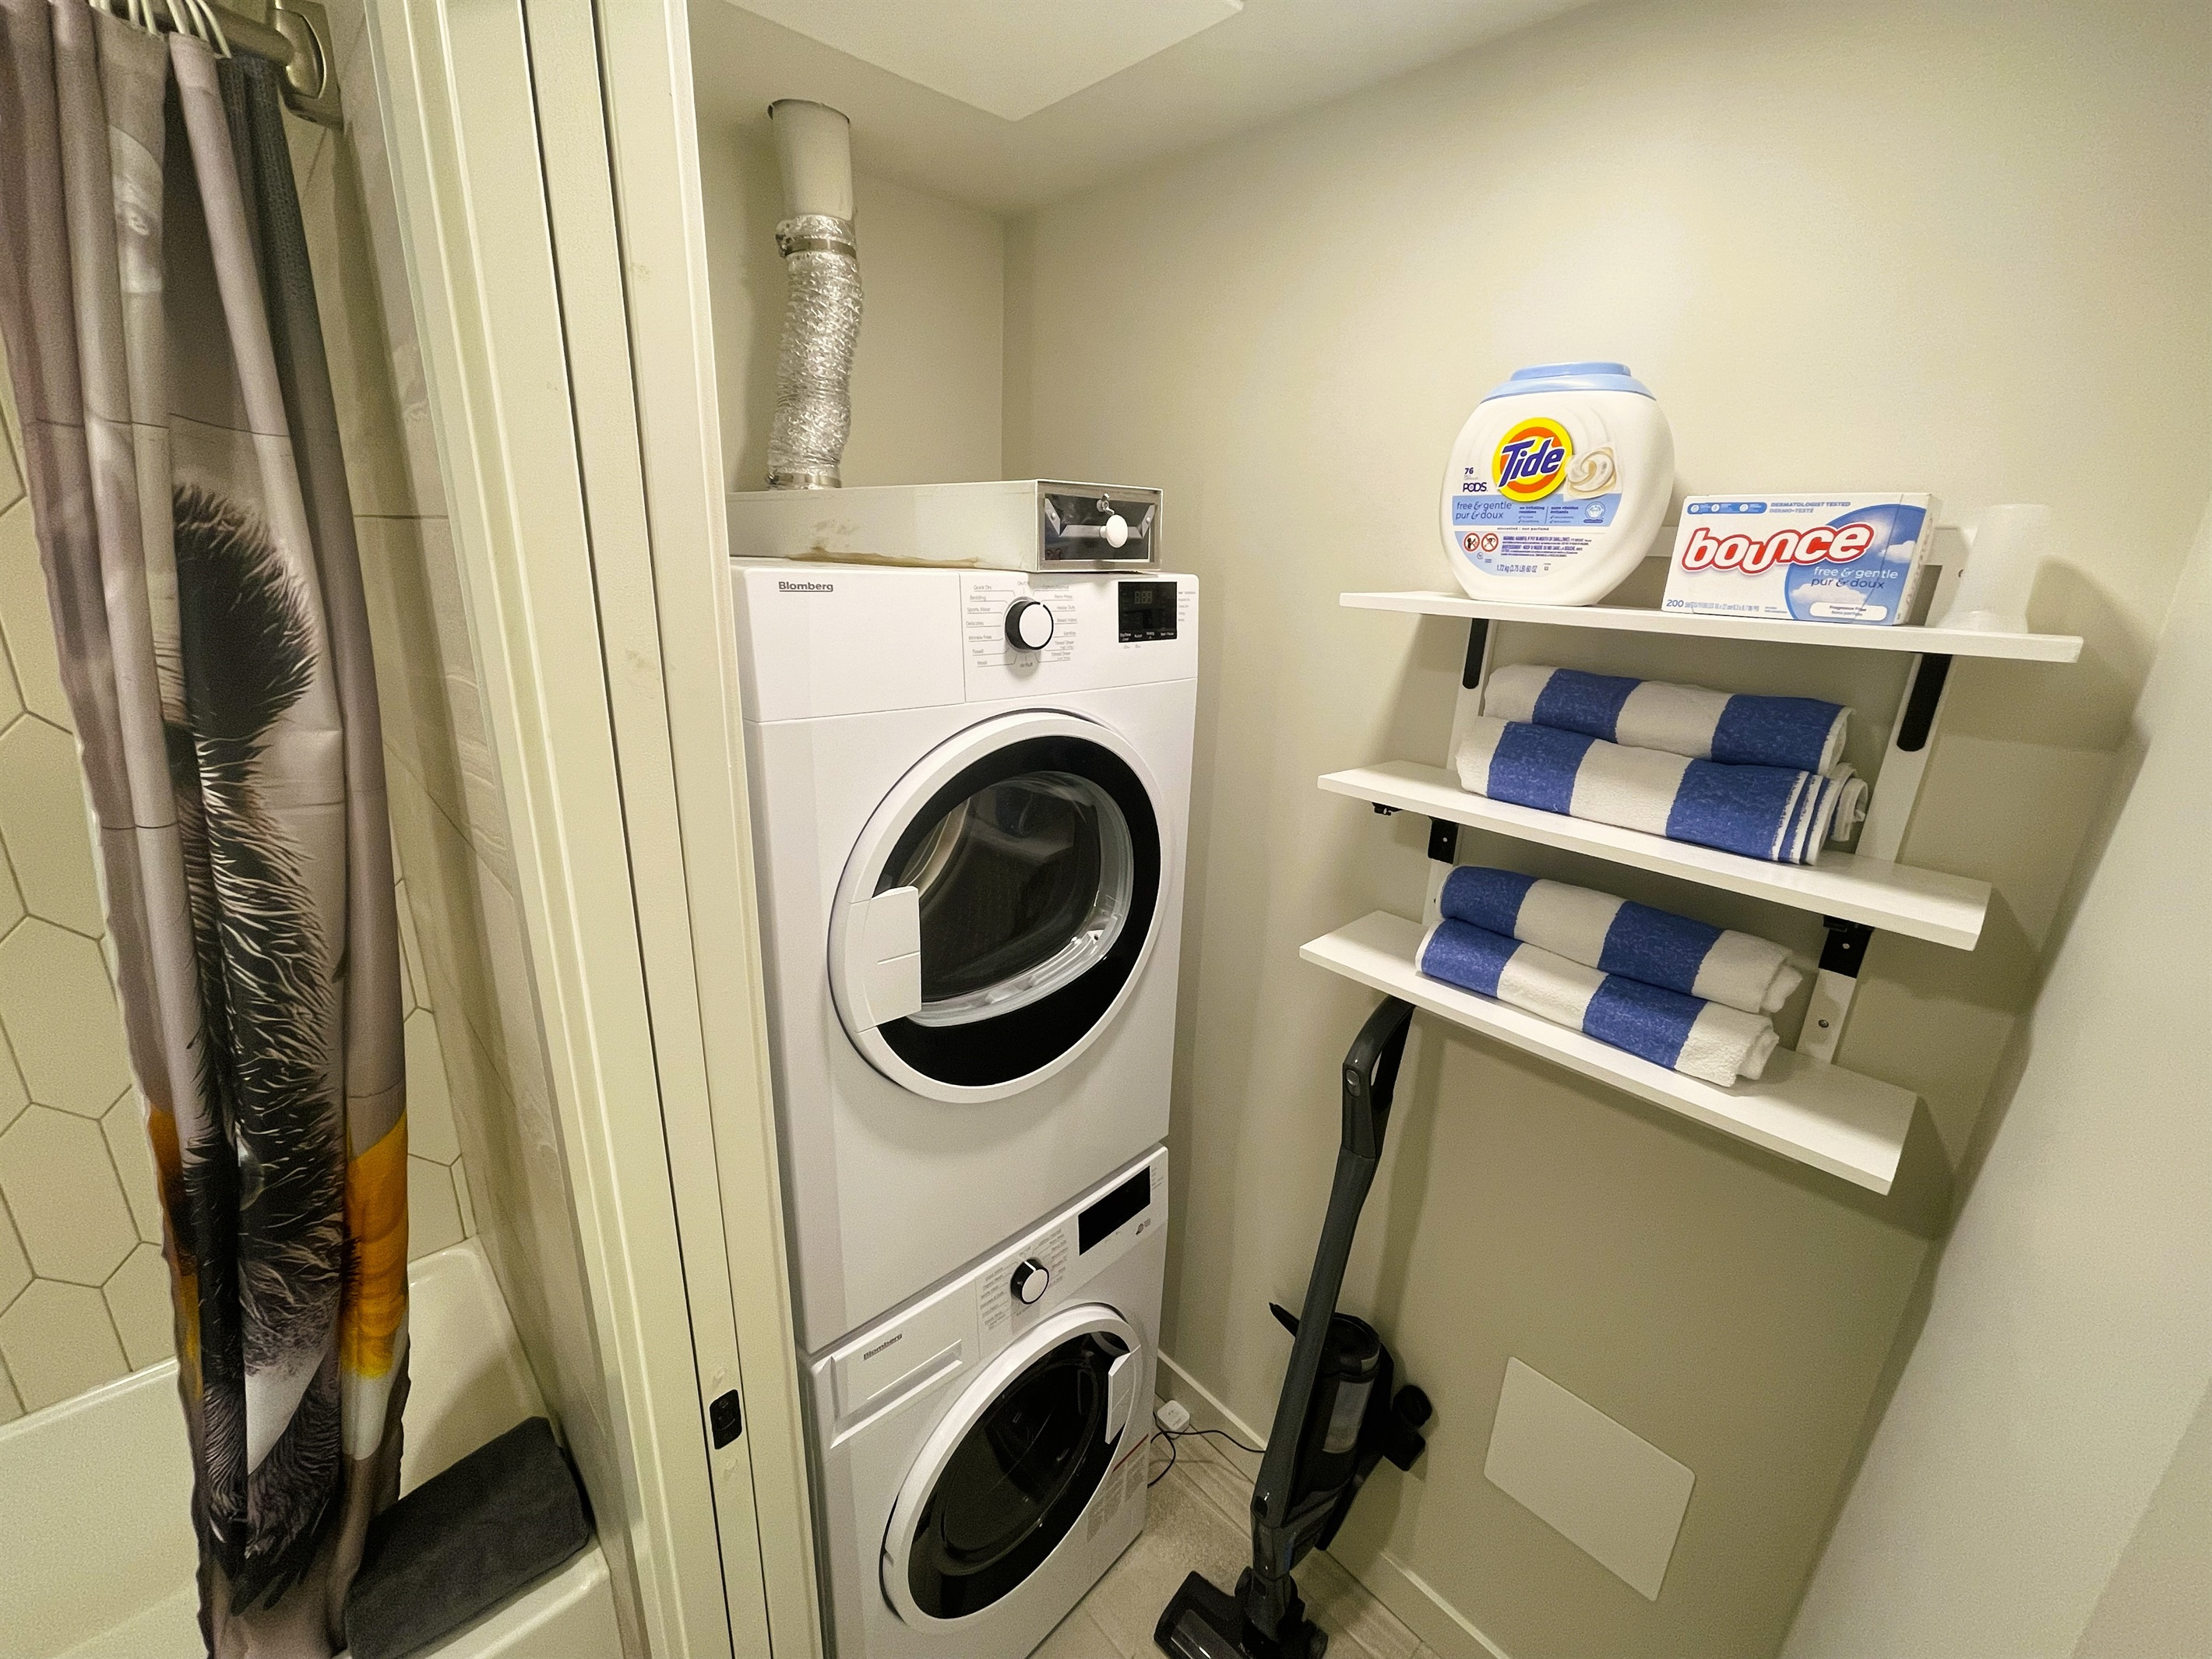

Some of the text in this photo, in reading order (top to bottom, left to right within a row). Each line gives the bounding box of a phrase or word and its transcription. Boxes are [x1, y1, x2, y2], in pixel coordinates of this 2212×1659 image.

[1498, 439, 1566, 488] Tide
[1462, 482, 1487, 492] PODS
[1456, 501, 1474, 510] free
[1484, 502, 1512, 513] gentle
[1456, 512, 1469, 521] pur
[1481, 511, 1504, 520] doux
[1682, 522, 1875, 575] bounce
[1814, 566, 1899, 579] free & gentle
[778, 581, 834, 593] Blomberg
[1811, 578, 1885, 589] pur & doux
[1666, 599, 1684, 608] 200
[863, 1333, 903, 1361] Blomberg
